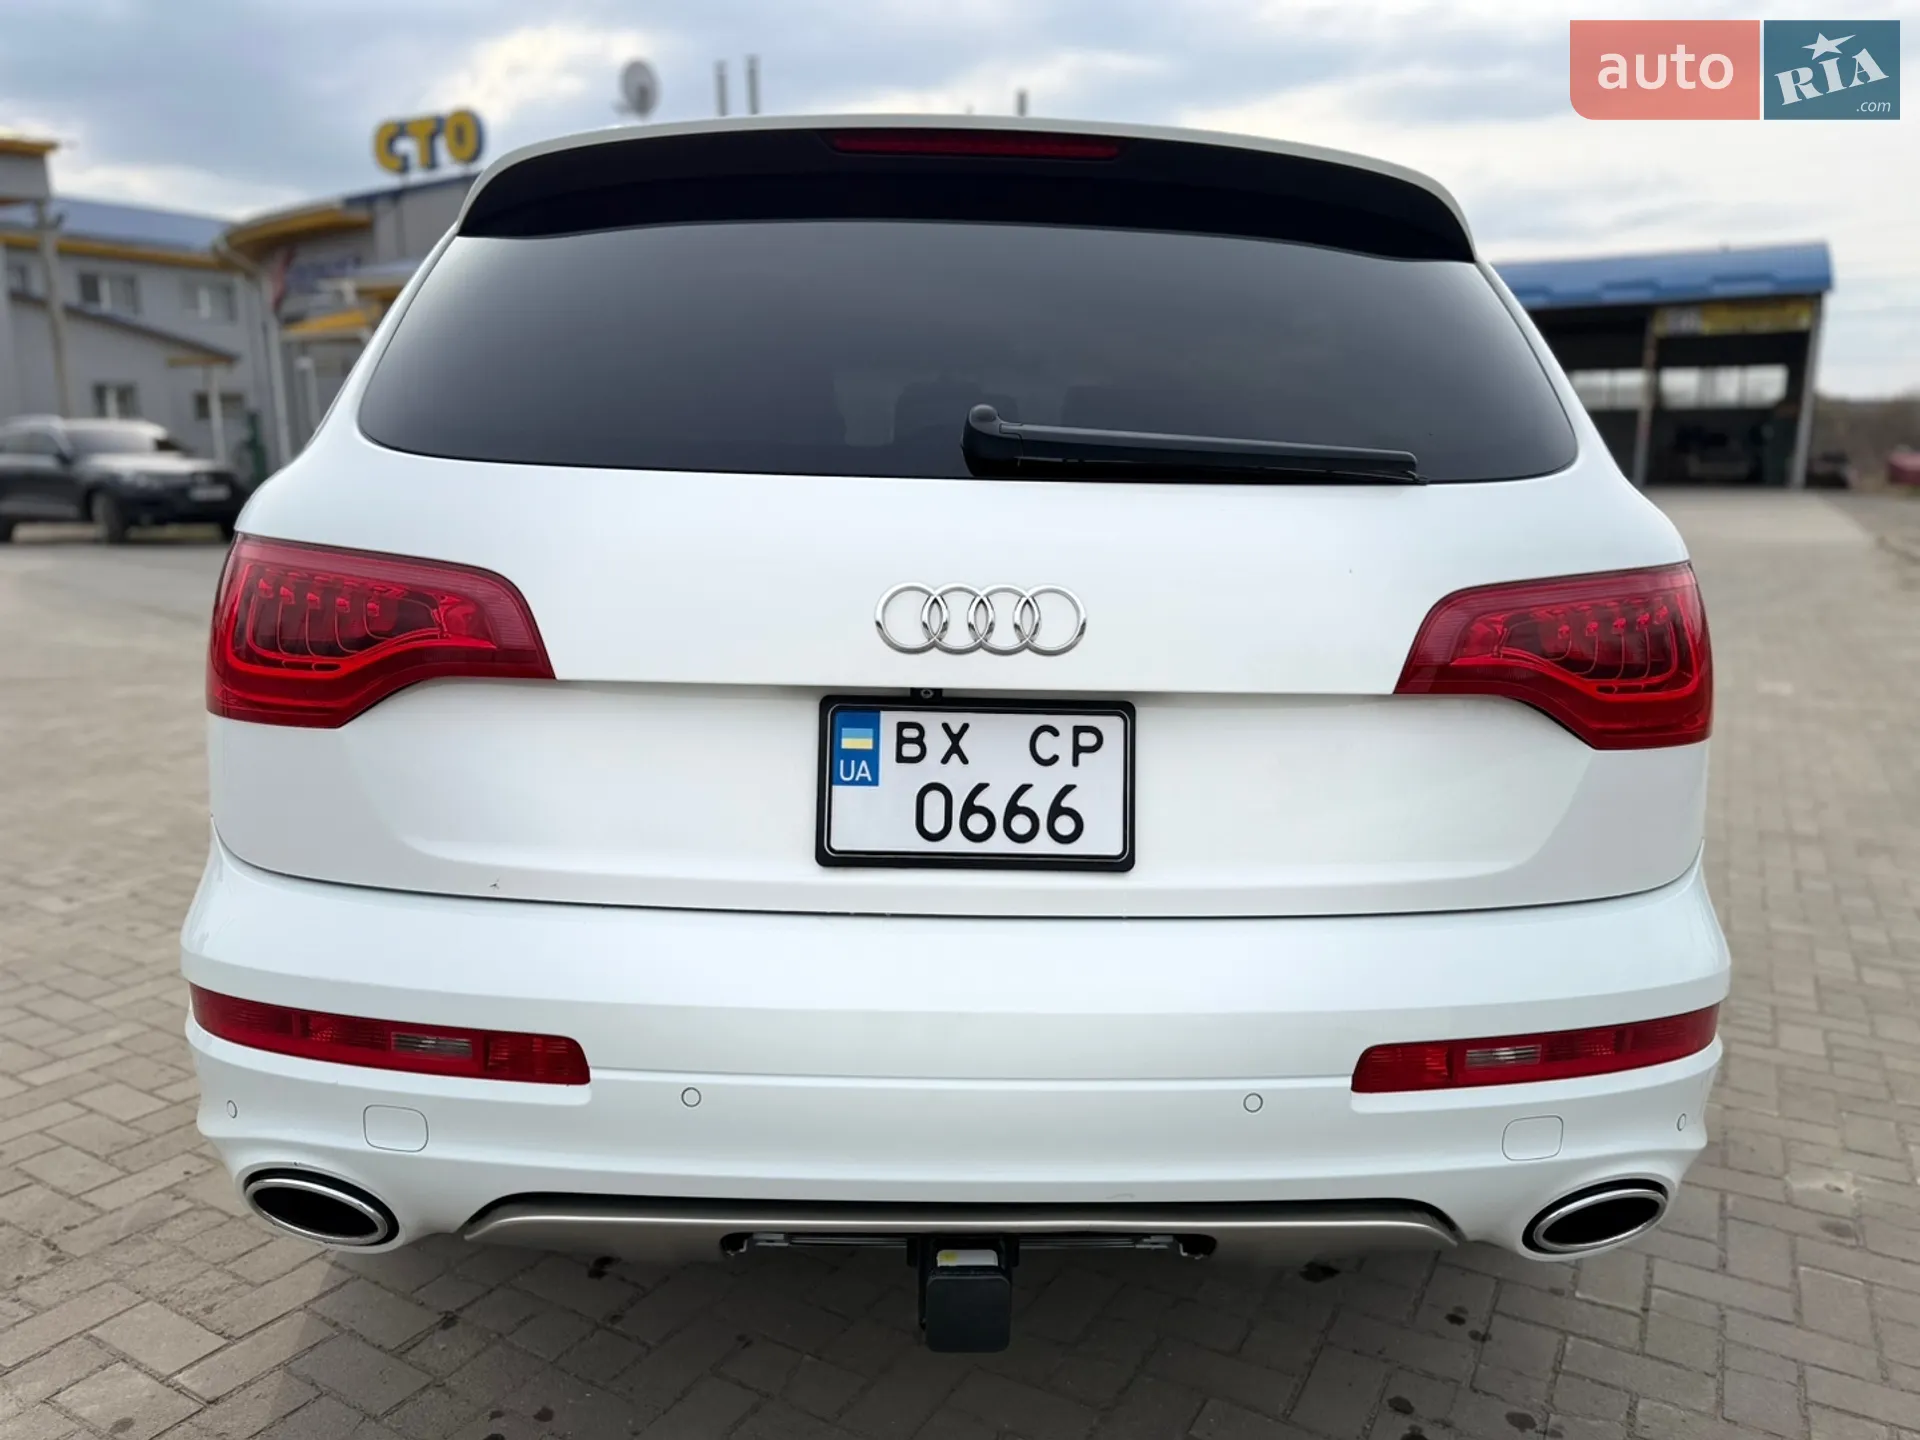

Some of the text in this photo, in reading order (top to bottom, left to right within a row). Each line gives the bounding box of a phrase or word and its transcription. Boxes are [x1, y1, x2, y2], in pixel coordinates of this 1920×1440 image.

[374, 108, 484, 174] СТО
[839, 759, 872, 782] UA
[895, 721, 1104, 768] BX CP
[915, 781, 1084, 845] 0666
